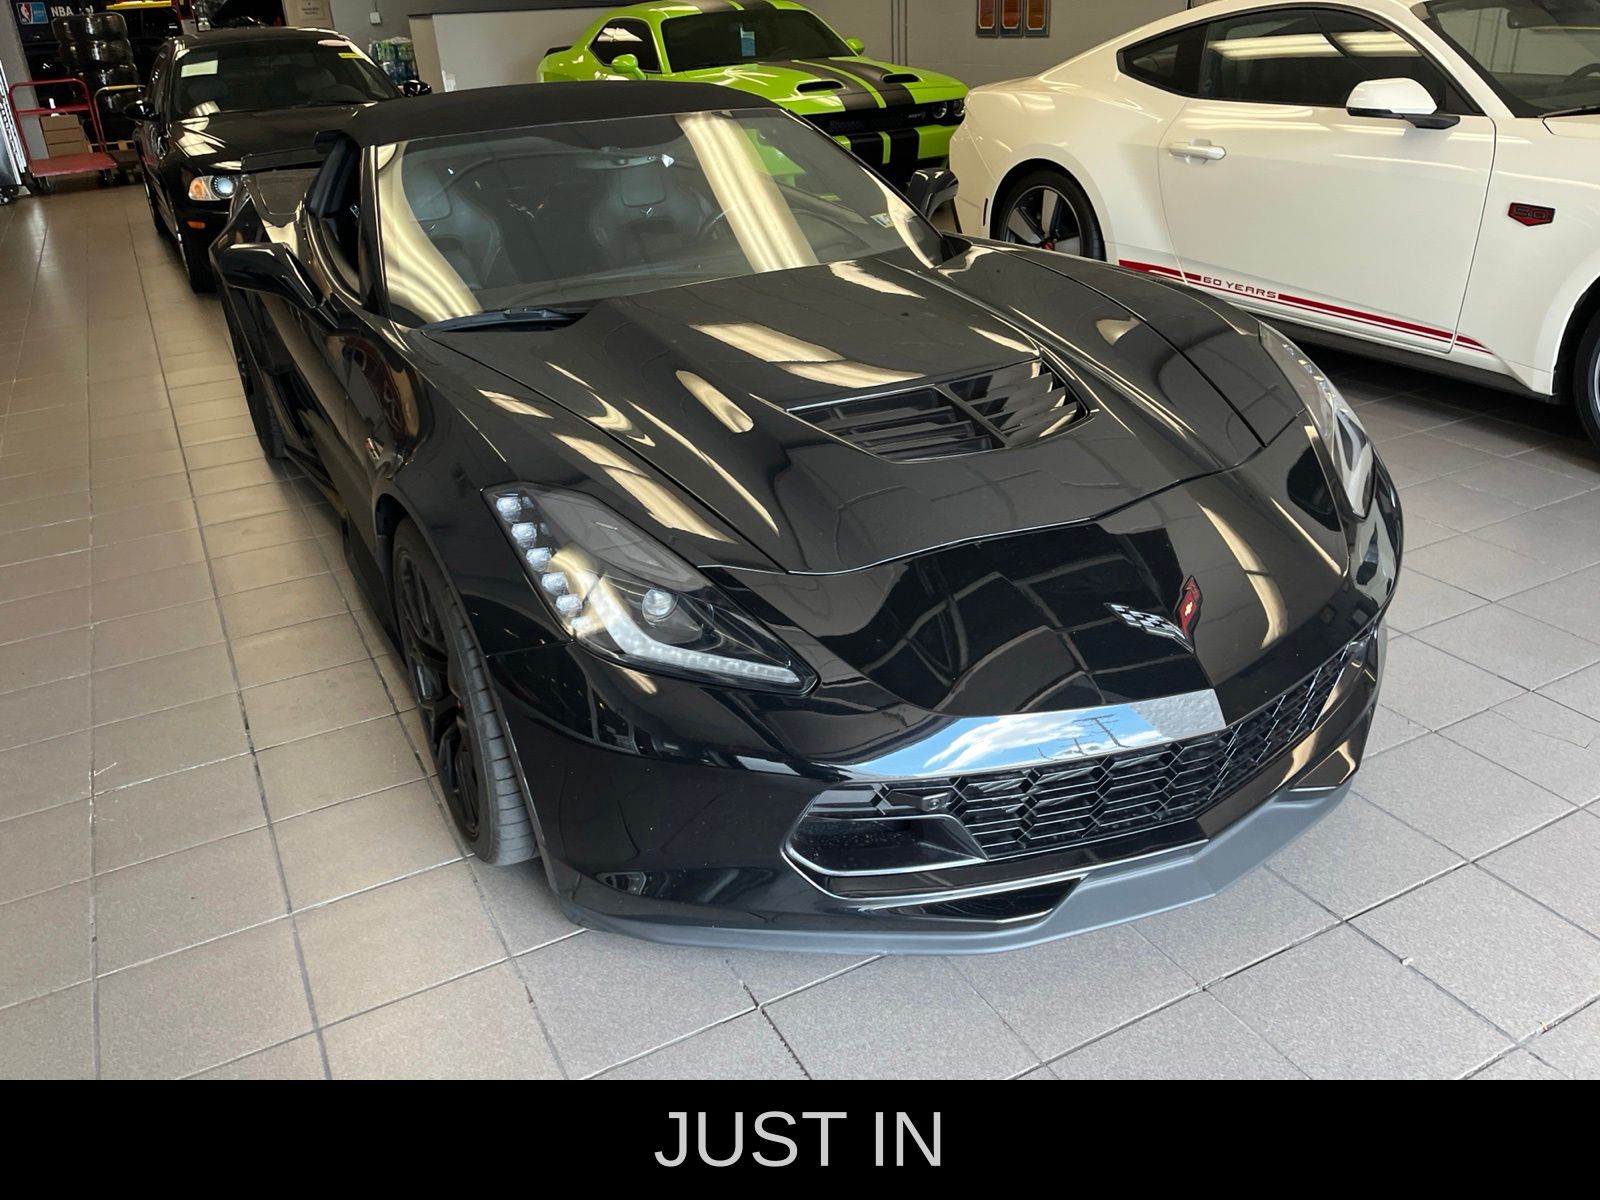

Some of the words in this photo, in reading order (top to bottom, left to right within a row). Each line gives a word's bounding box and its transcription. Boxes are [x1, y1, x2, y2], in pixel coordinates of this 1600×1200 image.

[50, 6, 74, 17] NBA
[1203, 276, 1222, 286] 60
[1226, 281, 1277, 299] YEARS
